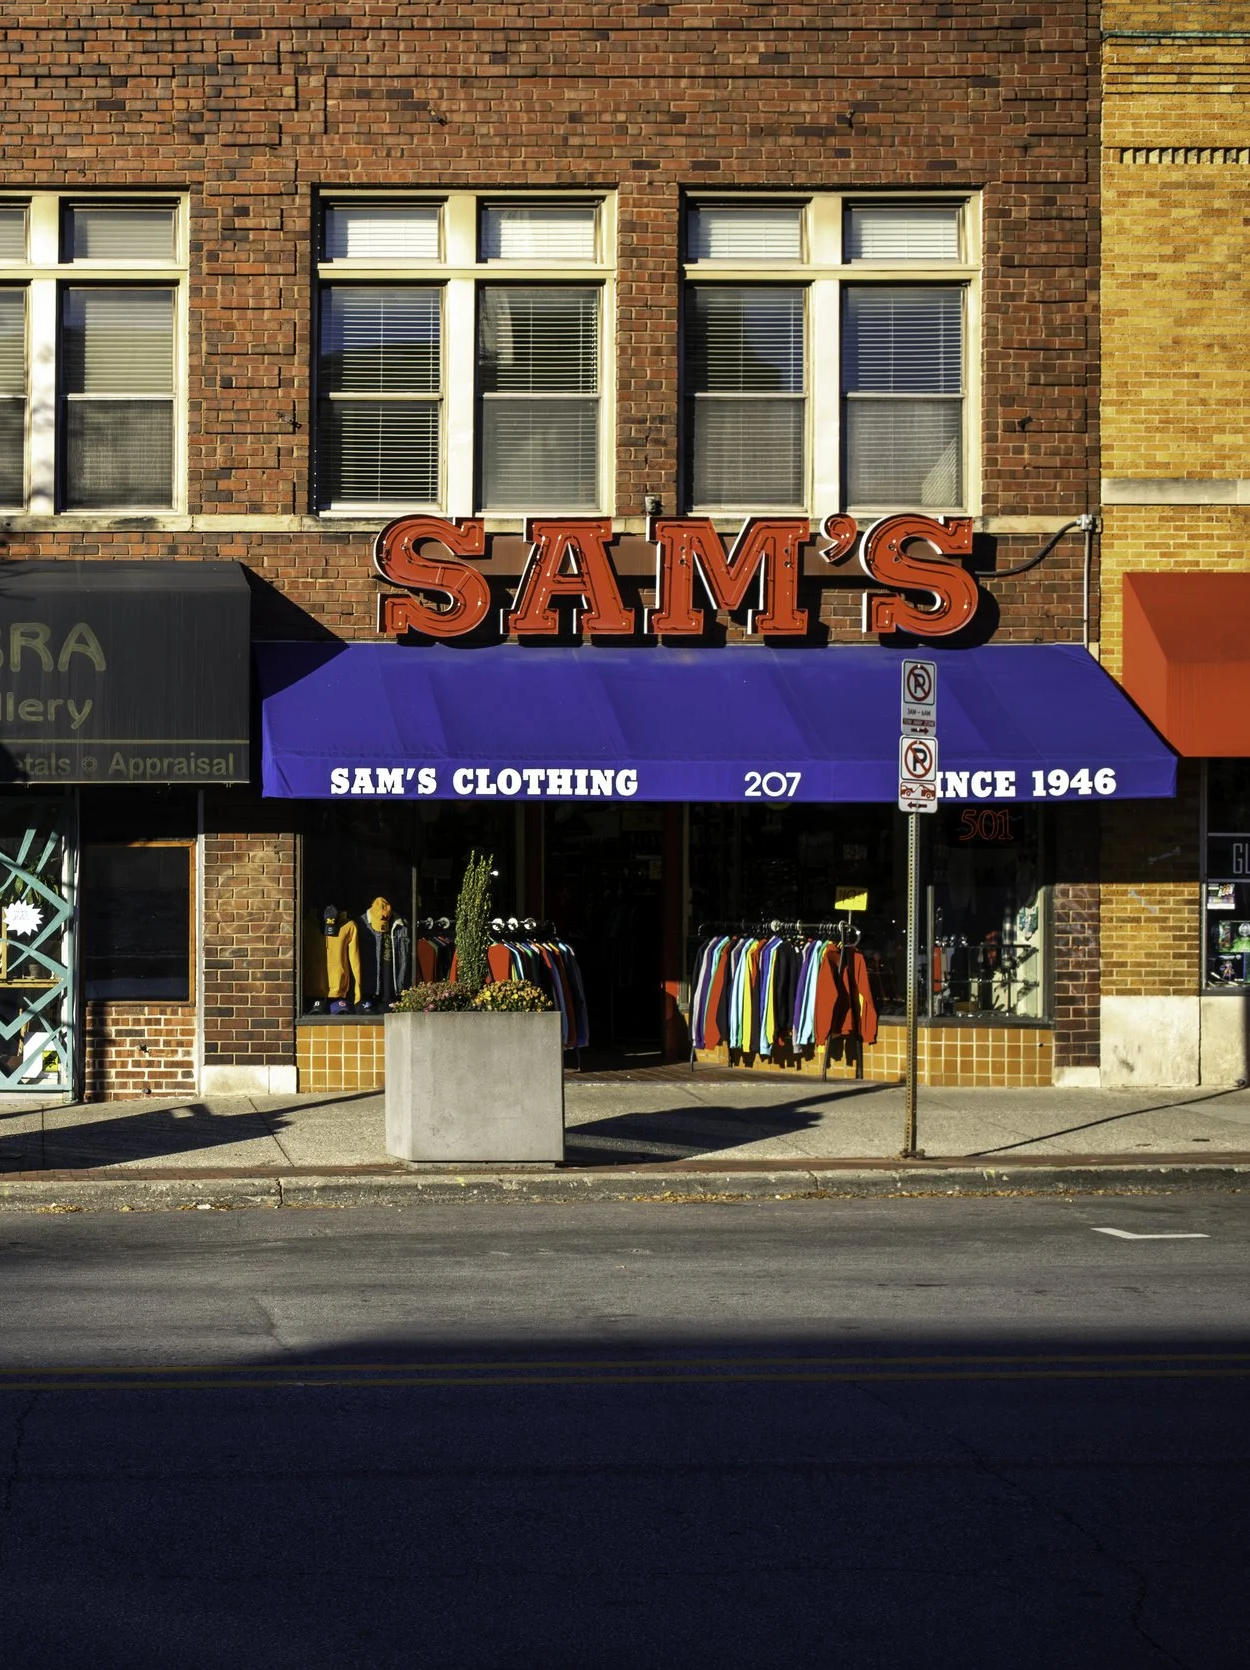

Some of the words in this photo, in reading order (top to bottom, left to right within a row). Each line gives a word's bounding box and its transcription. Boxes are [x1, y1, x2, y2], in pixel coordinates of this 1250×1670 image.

[375, 513, 980, 637] SAM'S
[108, 752, 234, 781] Appraisal
[330, 767, 437, 795] SAM'S
[452, 768, 638, 797] CLOTHING
[744, 772, 802, 797] 207
[936, 770, 1016, 798] INCE
[1032, 768, 1117, 797] 1946
[959, 809, 1014, 841] 501
